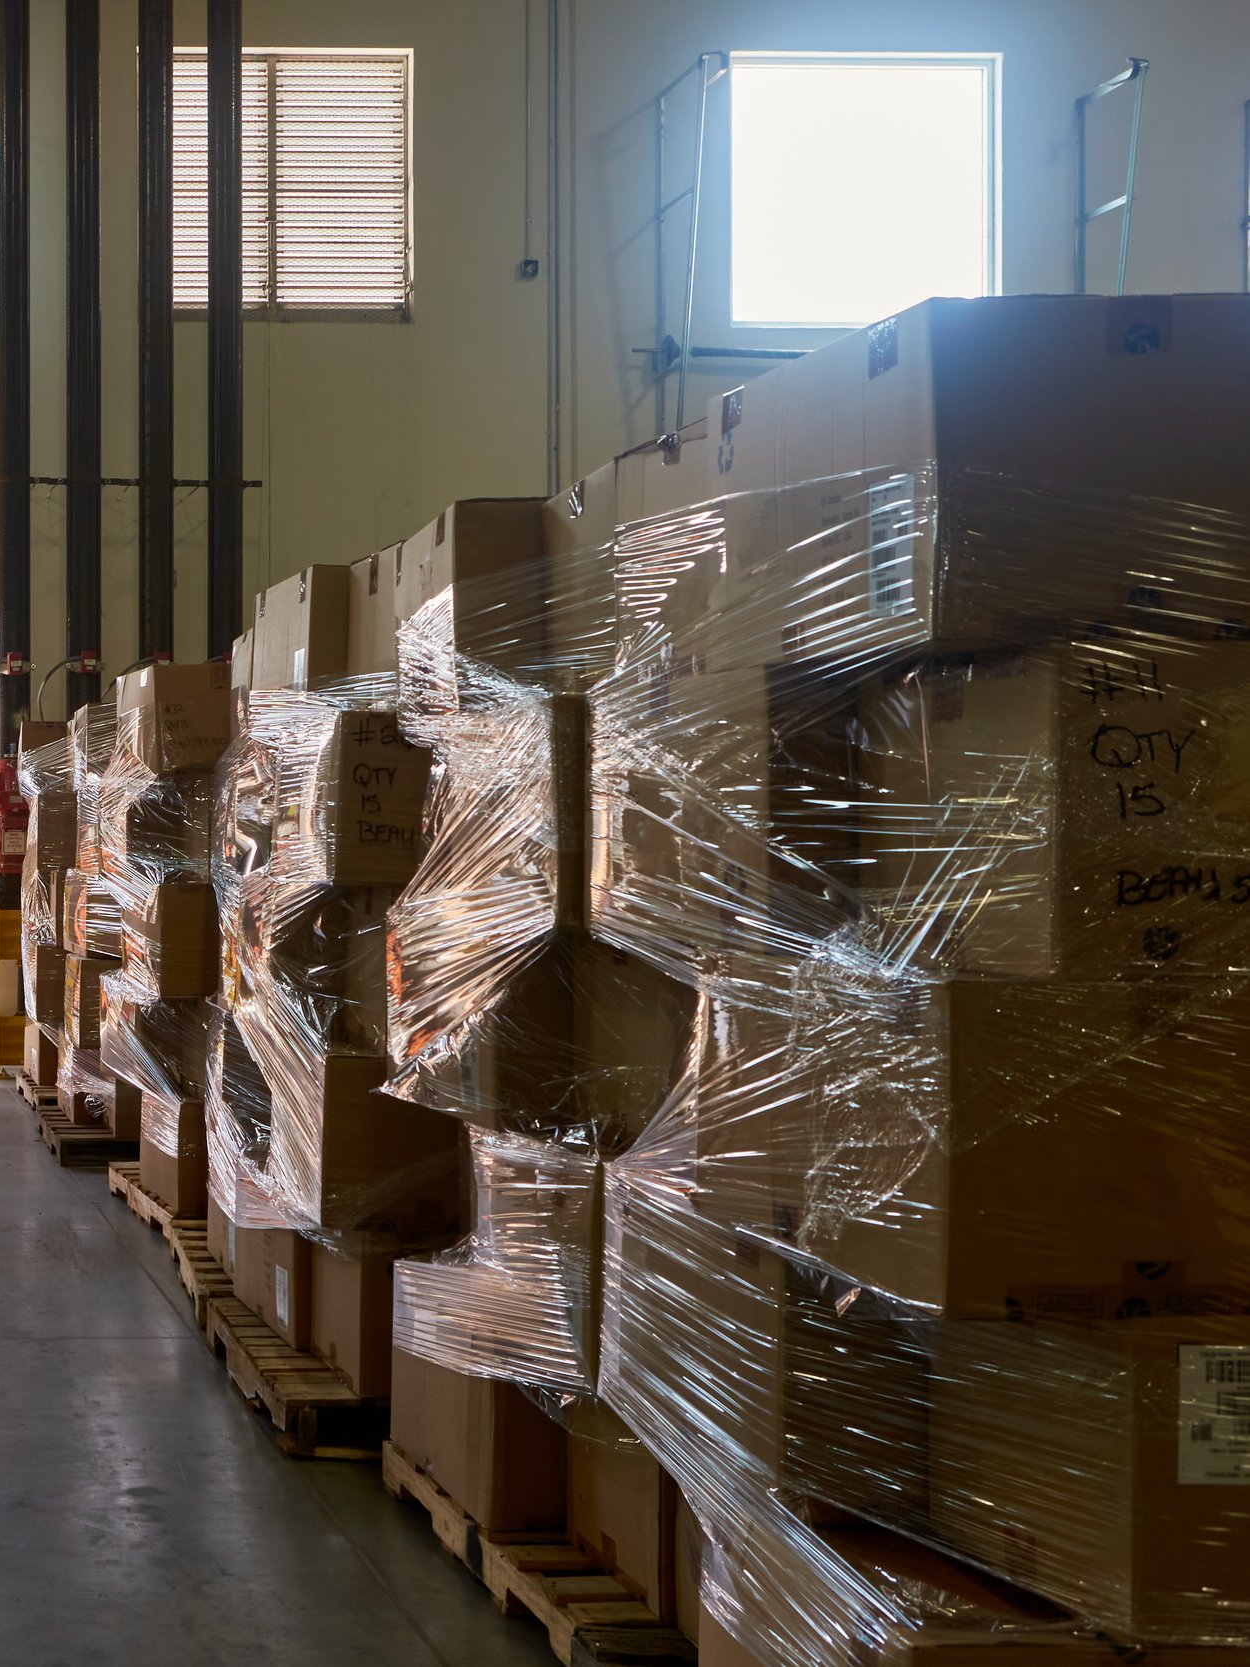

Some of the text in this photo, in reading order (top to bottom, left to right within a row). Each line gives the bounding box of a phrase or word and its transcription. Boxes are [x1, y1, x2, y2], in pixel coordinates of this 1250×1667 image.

[1091, 723, 1197, 774] QTY
[352, 762, 398, 788] QTY
[361, 794, 382, 814] 15
[1116, 781, 1167, 820] 15
